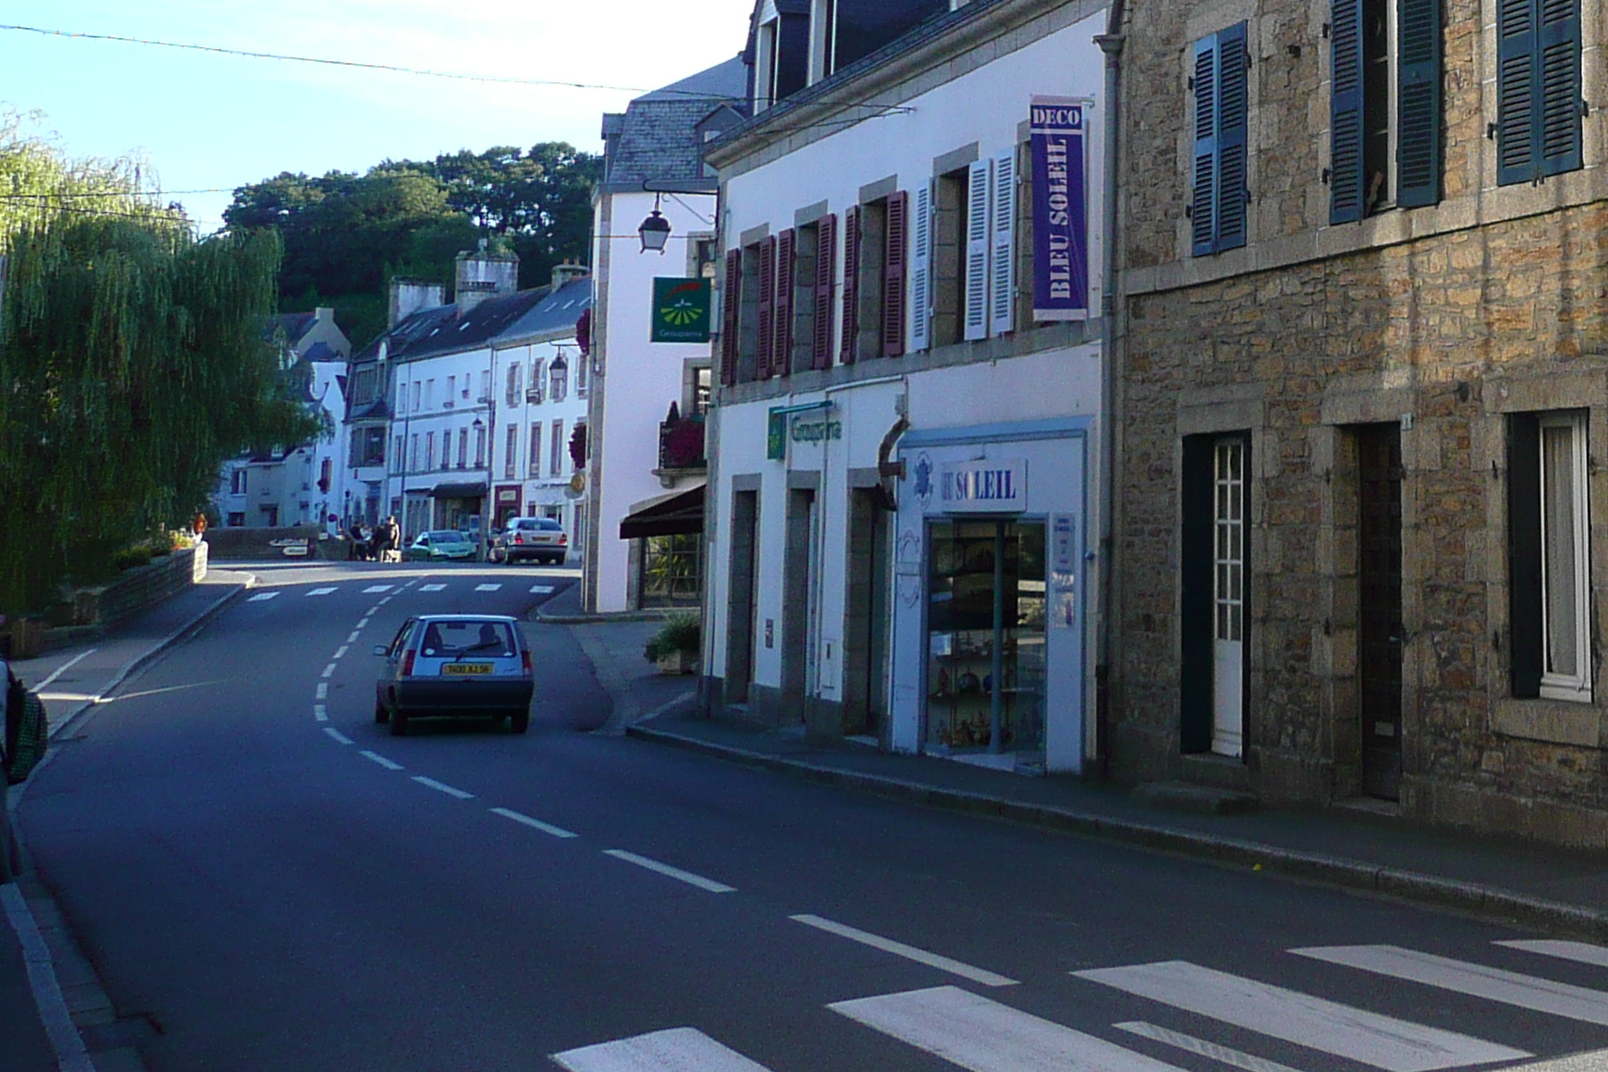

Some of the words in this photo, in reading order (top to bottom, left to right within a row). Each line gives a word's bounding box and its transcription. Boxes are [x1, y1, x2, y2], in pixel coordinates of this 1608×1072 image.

[1032, 108, 1080, 125] DECO
[1047, 139, 1069, 226] SOLEIL
[1050, 234, 1071, 300] BLEU
[956, 470, 1016, 500] SOLEIL
